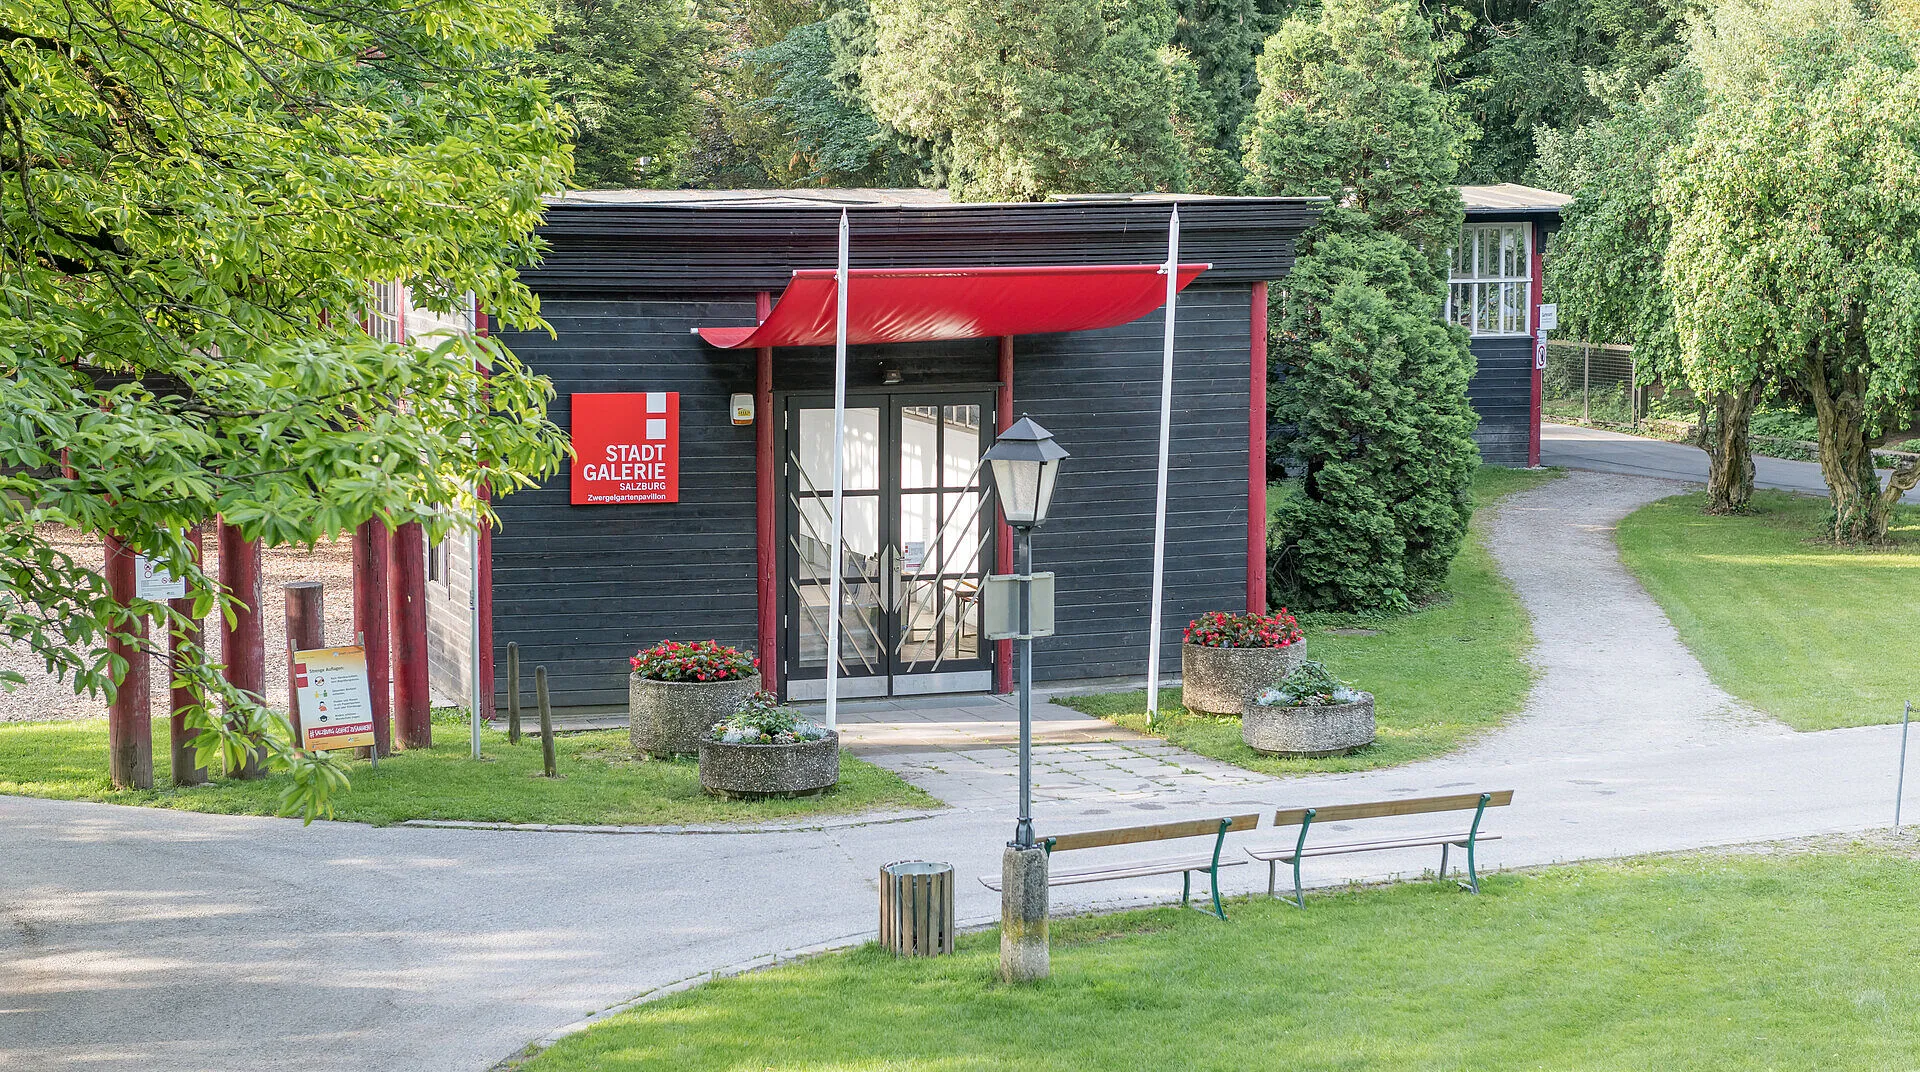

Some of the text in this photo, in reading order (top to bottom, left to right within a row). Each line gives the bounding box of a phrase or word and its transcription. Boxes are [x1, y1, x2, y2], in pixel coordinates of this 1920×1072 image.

[605, 444, 666, 462] STADT
[583, 463, 666, 481] GALERIE
[619, 482, 666, 491] SALZBURG
[587, 493, 666, 502] Zwergelgartenpavillon
